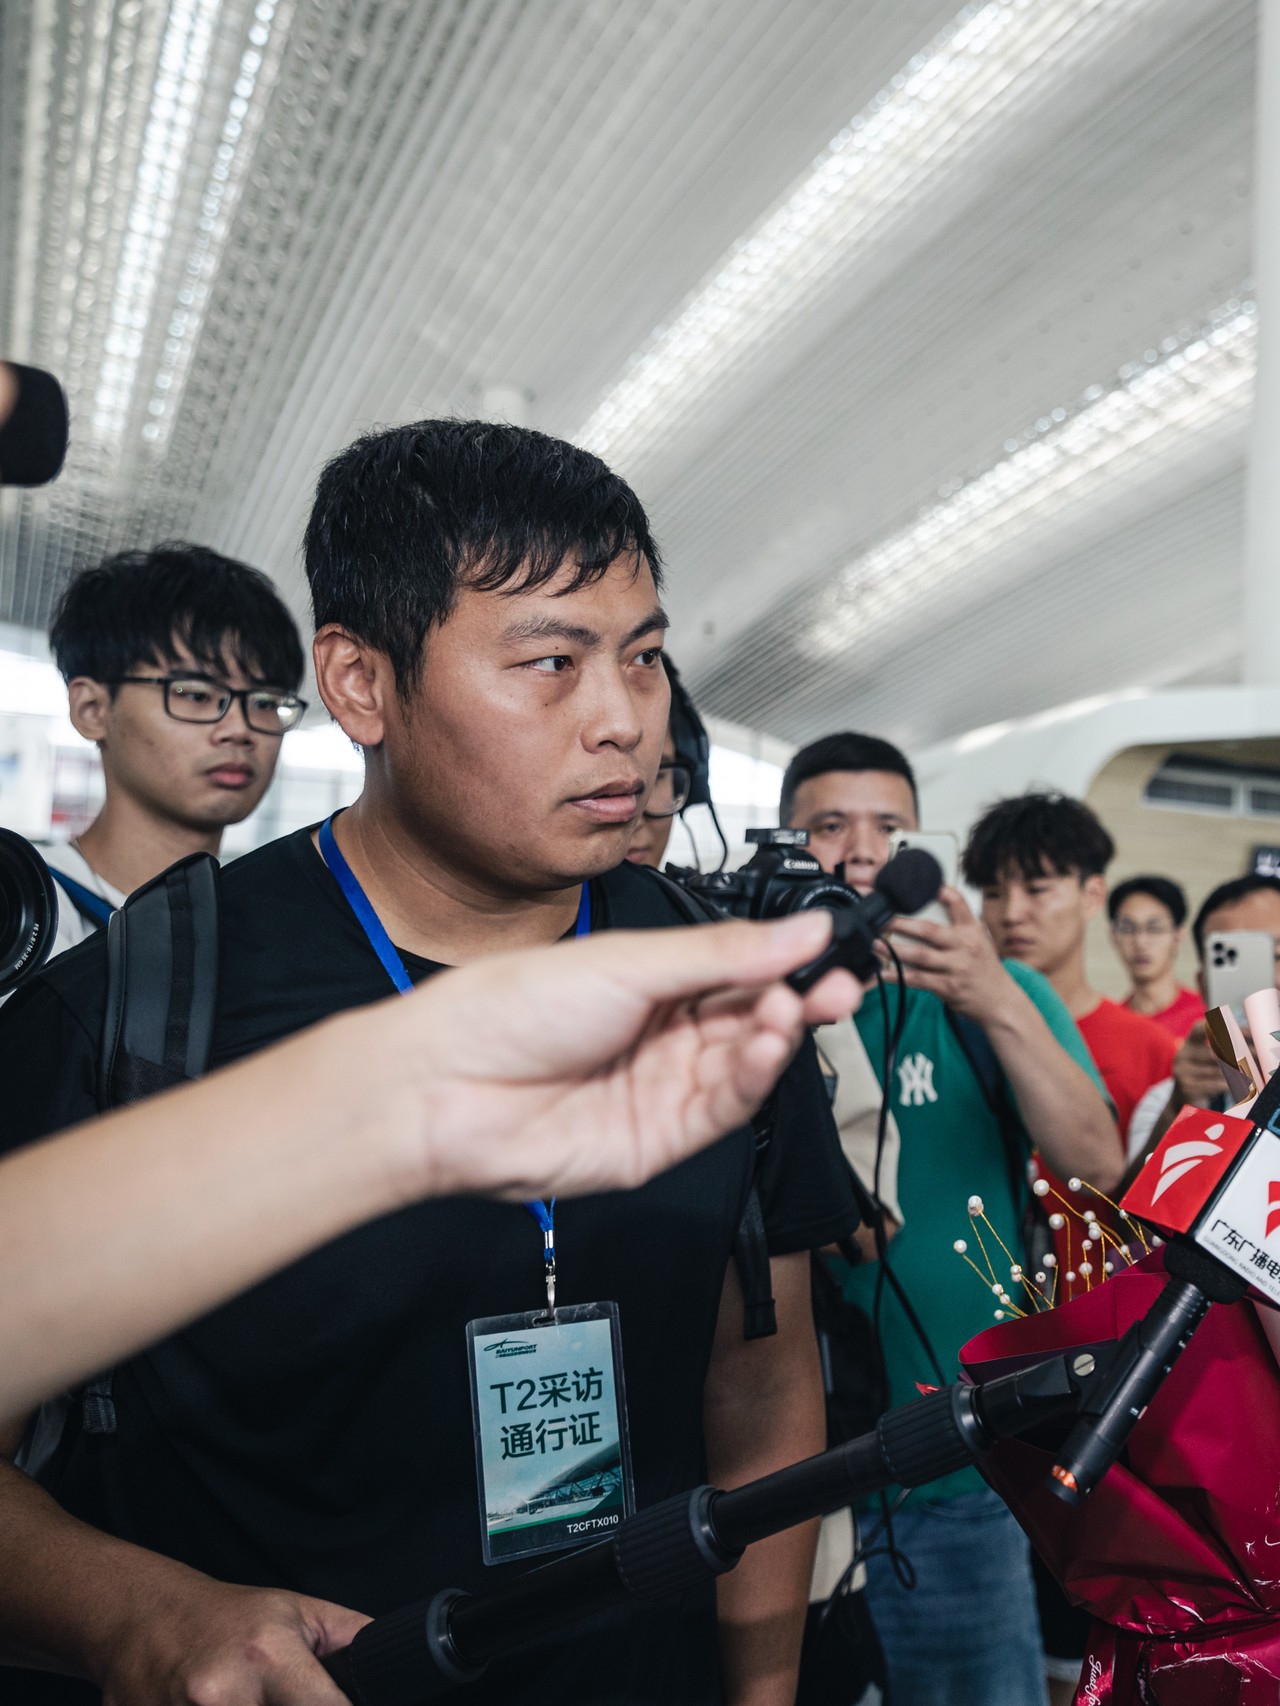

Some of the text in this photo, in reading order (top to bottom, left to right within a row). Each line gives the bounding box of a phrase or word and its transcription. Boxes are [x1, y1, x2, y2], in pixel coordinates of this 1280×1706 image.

[783, 858, 819, 871] Canon
[897, 1051, 939, 1107] NY
[490, 1367, 603, 1414] T2采访
[500, 1411, 602, 1460] 通行证
[566, 1514, 619, 1534] T2CFTX010
[1088, 1654, 1102, 1691] Just
